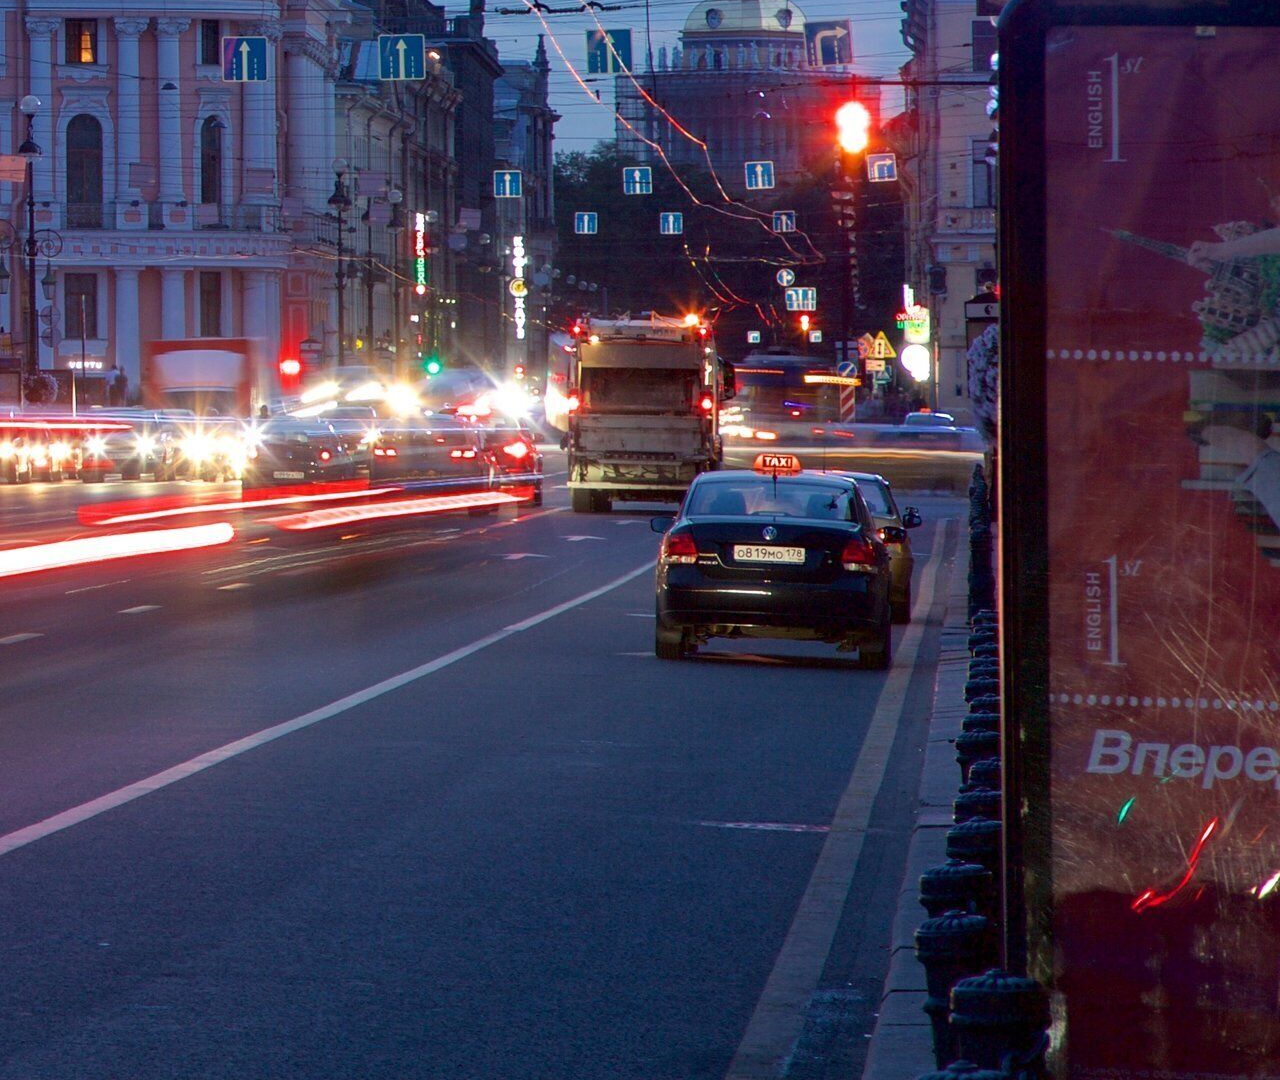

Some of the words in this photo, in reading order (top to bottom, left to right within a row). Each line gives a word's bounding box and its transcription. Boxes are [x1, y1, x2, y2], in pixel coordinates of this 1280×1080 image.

[1088, 69, 1102, 149] ENGLISH
[764, 456, 793, 468] TAXI
[1086, 570, 1102, 652] ENGLISH
[1086, 729, 1280, 789] Впере
